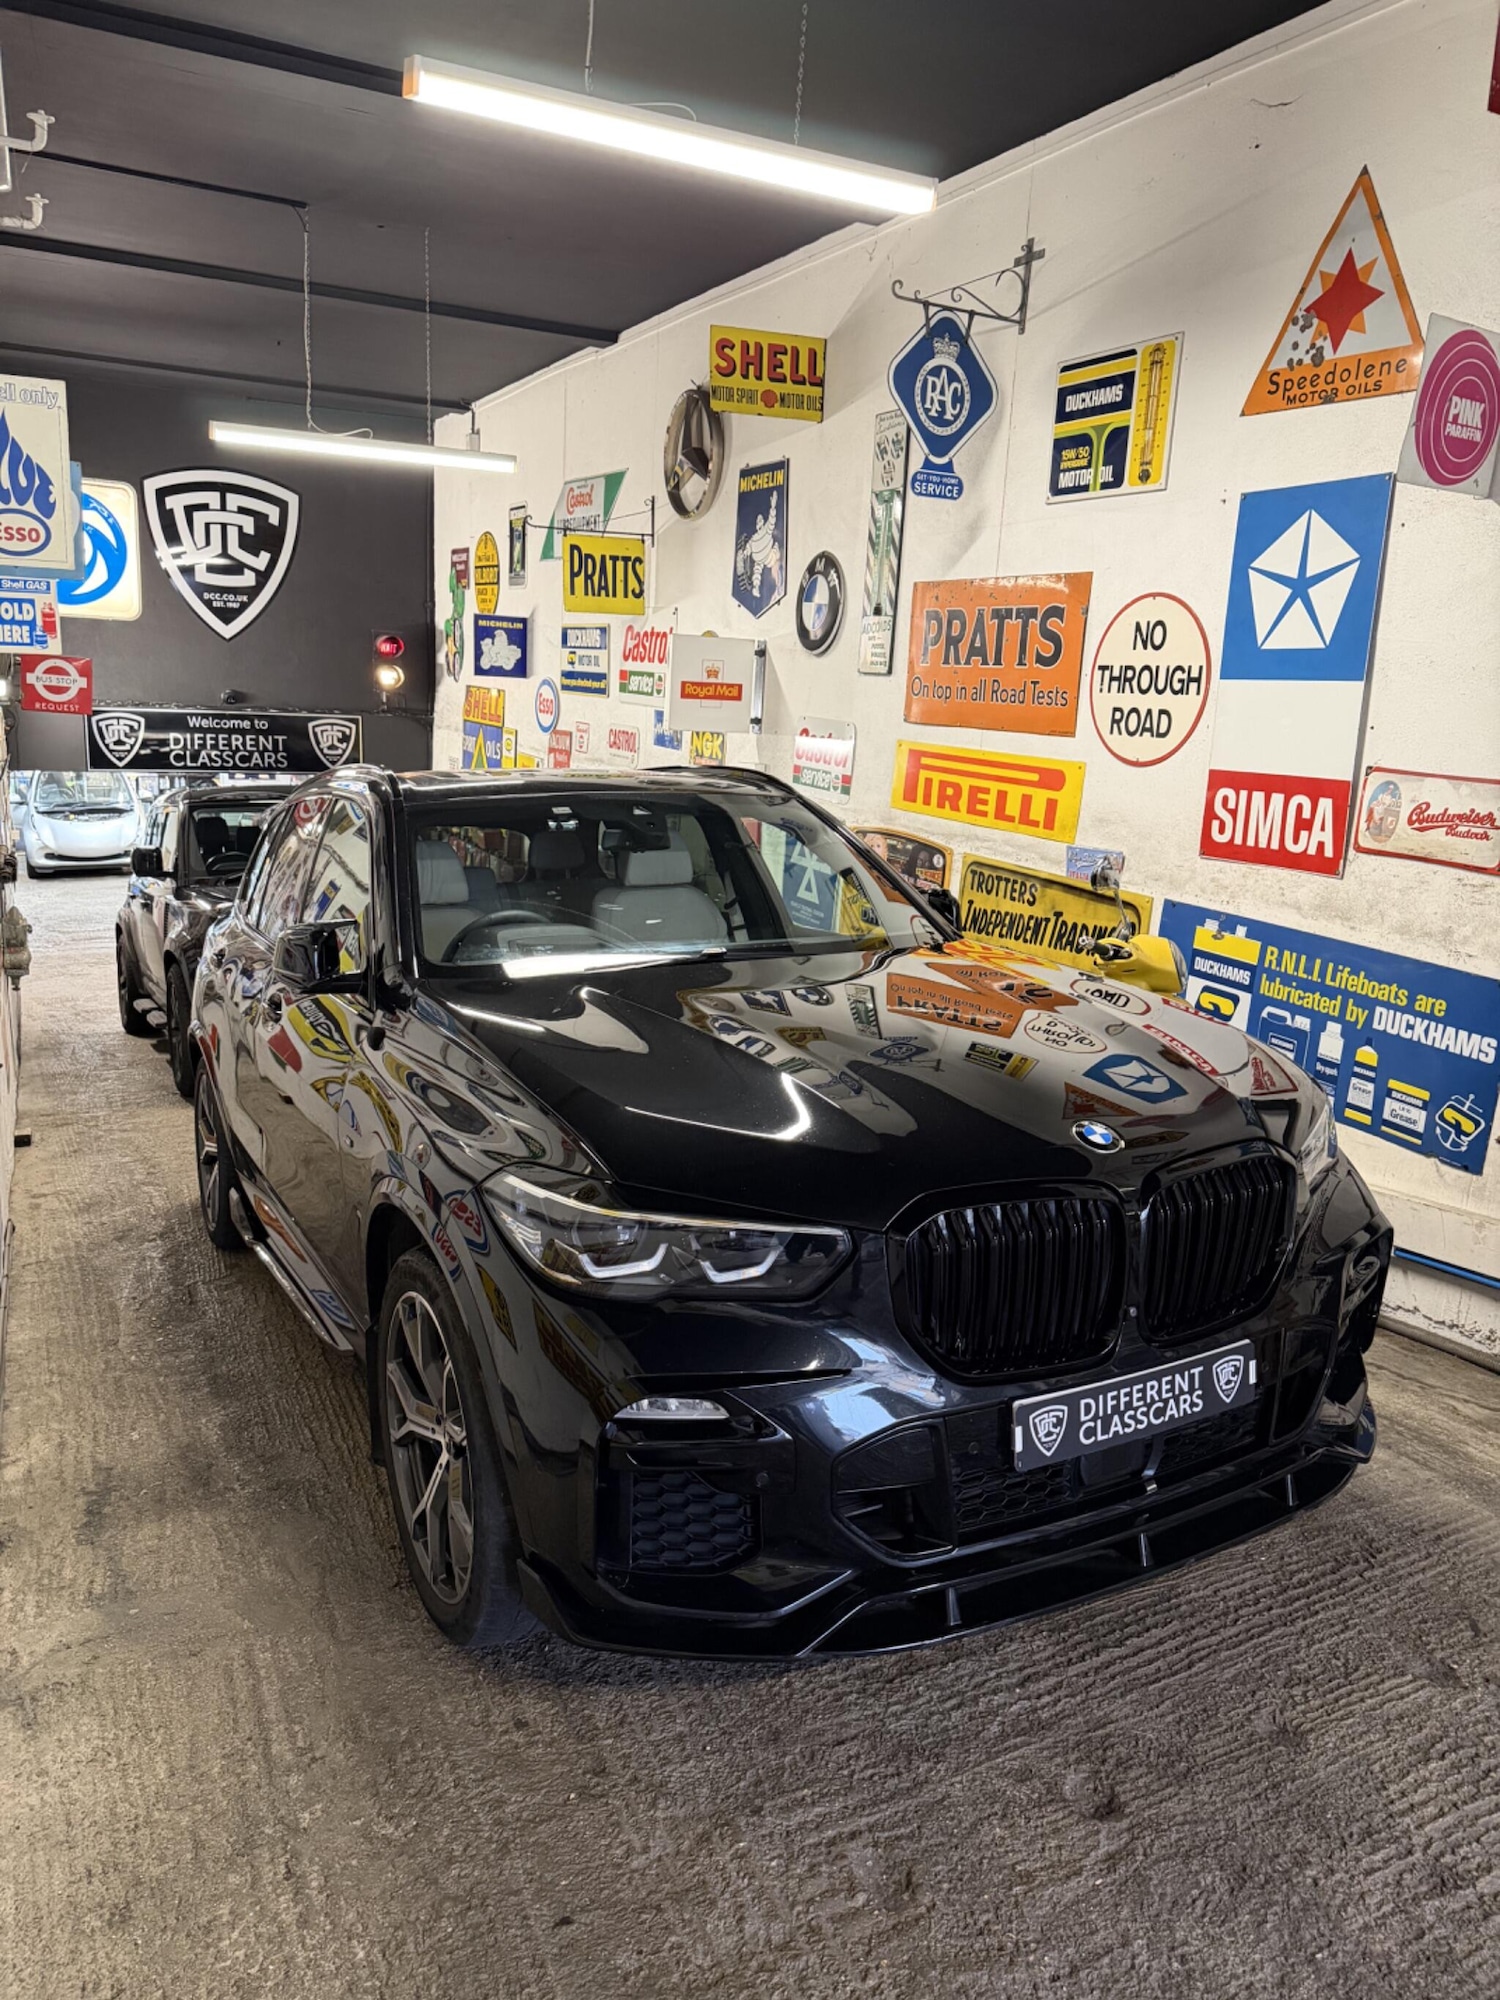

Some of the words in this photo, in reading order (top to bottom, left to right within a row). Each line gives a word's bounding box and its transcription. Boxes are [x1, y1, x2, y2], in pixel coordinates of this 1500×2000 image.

[714, 337, 824, 387] SHELL
[1267, 358, 1408, 401] Speedolene
[1286, 387, 1339, 405] MOTOR
[1345, 379, 1383, 396] OILS
[20, 386, 60, 409] only
[711, 385, 735, 402] MOTOR
[736, 387, 759, 406] SPIRIT
[780, 391, 804, 410] MOTOR
[806, 394, 823, 411] OILS
[924, 367, 962, 420] RAC
[1065, 383, 1124, 413] DUCKHAMS
[1448, 395, 1485, 429] PINK
[1445, 422, 1482, 443] PARAFFIN
[740, 469, 784, 493] MICHELIN
[913, 481, 960, 499] SERVICE
[1058, 468, 1094, 489] MOTOR
[1099, 464, 1114, 483] OIL
[566, 483, 595, 516] Castrol
[569, 543, 644, 599] PRATTS
[1, 579, 25, 589] Shell
[25, 580, 48, 591] GAS
[203, 592, 249, 603] DCC.CO.UK
[478, 619, 523, 630] MICHELIN
[919, 603, 1067, 669] PRATTS
[1132, 620, 1168, 650] NO
[36, 675, 52, 684] BUS
[56, 676, 78, 686] STOP
[629, 674, 654, 694] service
[685, 683, 715, 698] Royal
[716, 685, 739, 698] Mail
[911, 676, 929, 697] On
[932, 679, 951, 703] top
[956, 681, 967, 701] in
[971, 678, 987, 702] all
[991, 679, 1027, 704] Road
[1031, 680, 1068, 707] Tests
[1098, 664, 1204, 696] THROUGH
[35, 701, 80, 713] REQUEST
[464, 687, 502, 724] SHELL
[187, 715, 251, 731] Welcome
[254, 717, 269, 730] to
[1109, 706, 1173, 739] ROAD
[169, 733, 288, 751] DIFFERENT
[486, 740, 501, 760] OILS
[608, 728, 637, 754] CASTROL
[692, 730, 724, 760] NGK
[169, 750, 288, 768] CLASSCARS
[801, 767, 832, 790] service
[902, 748, 1066, 831] PIRELLI
[1211, 787, 1334, 859] SIMCA
[1407, 800, 1497, 828] Budweiser
[969, 869, 1039, 907] TROTTERS
[1194, 956, 1252, 986] DUCKHAMS
[1264, 945, 1322, 984] R.N.L.I.
[1325, 962, 1409, 1007] Lifeboats
[1414, 994, 1447, 1017] are
[1259, 974, 1342, 1017] lubricated
[1346, 998, 1369, 1030] by
[1372, 1005, 1498, 1065] DUCKHAMS
[1352, 1082, 1372, 1095] Grease
[1389, 1108, 1418, 1127] Grease
[1080, 1366, 1204, 1422] DIFFERENT
[1079, 1390, 1204, 1446] CLASSCARS
